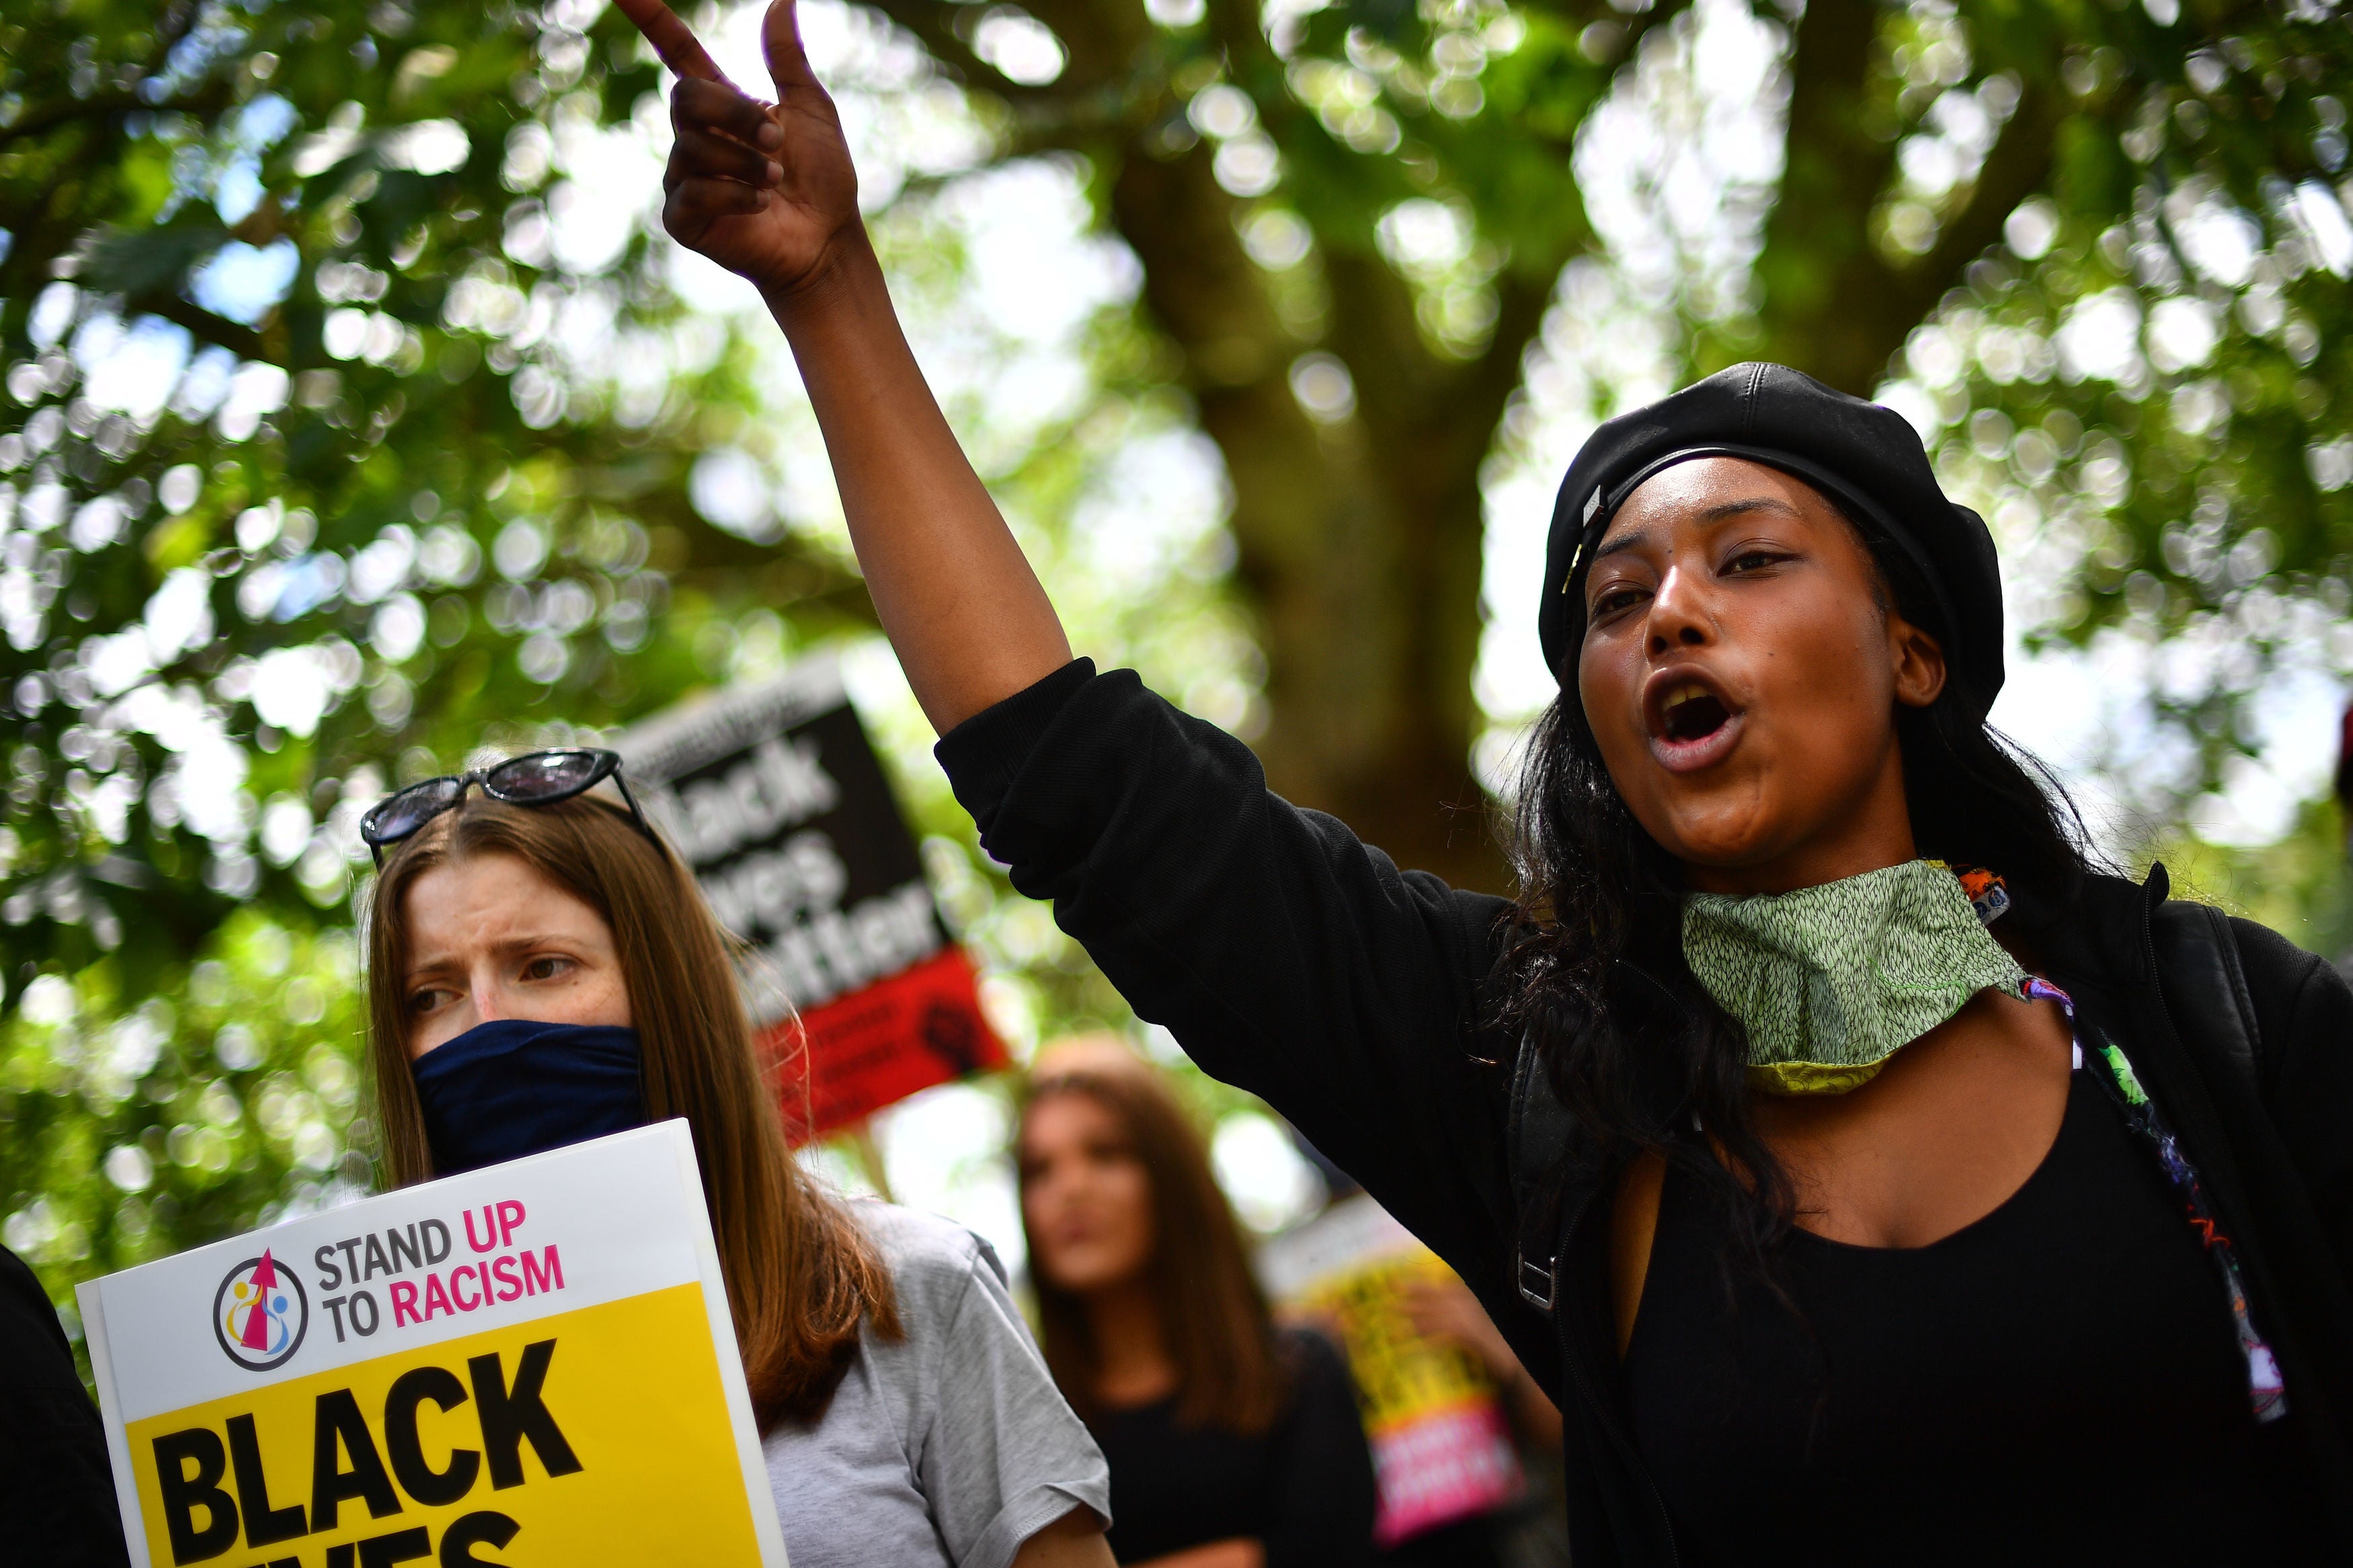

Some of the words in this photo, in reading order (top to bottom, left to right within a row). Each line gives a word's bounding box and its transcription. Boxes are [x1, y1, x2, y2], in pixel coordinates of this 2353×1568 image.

[314, 1218, 451, 1292] STAND
[463, 1200, 526, 1253] UP
[322, 1290, 379, 1344] TO
[390, 1244, 565, 1327] RACISM
[152, 1339, 583, 1567] BLACK
